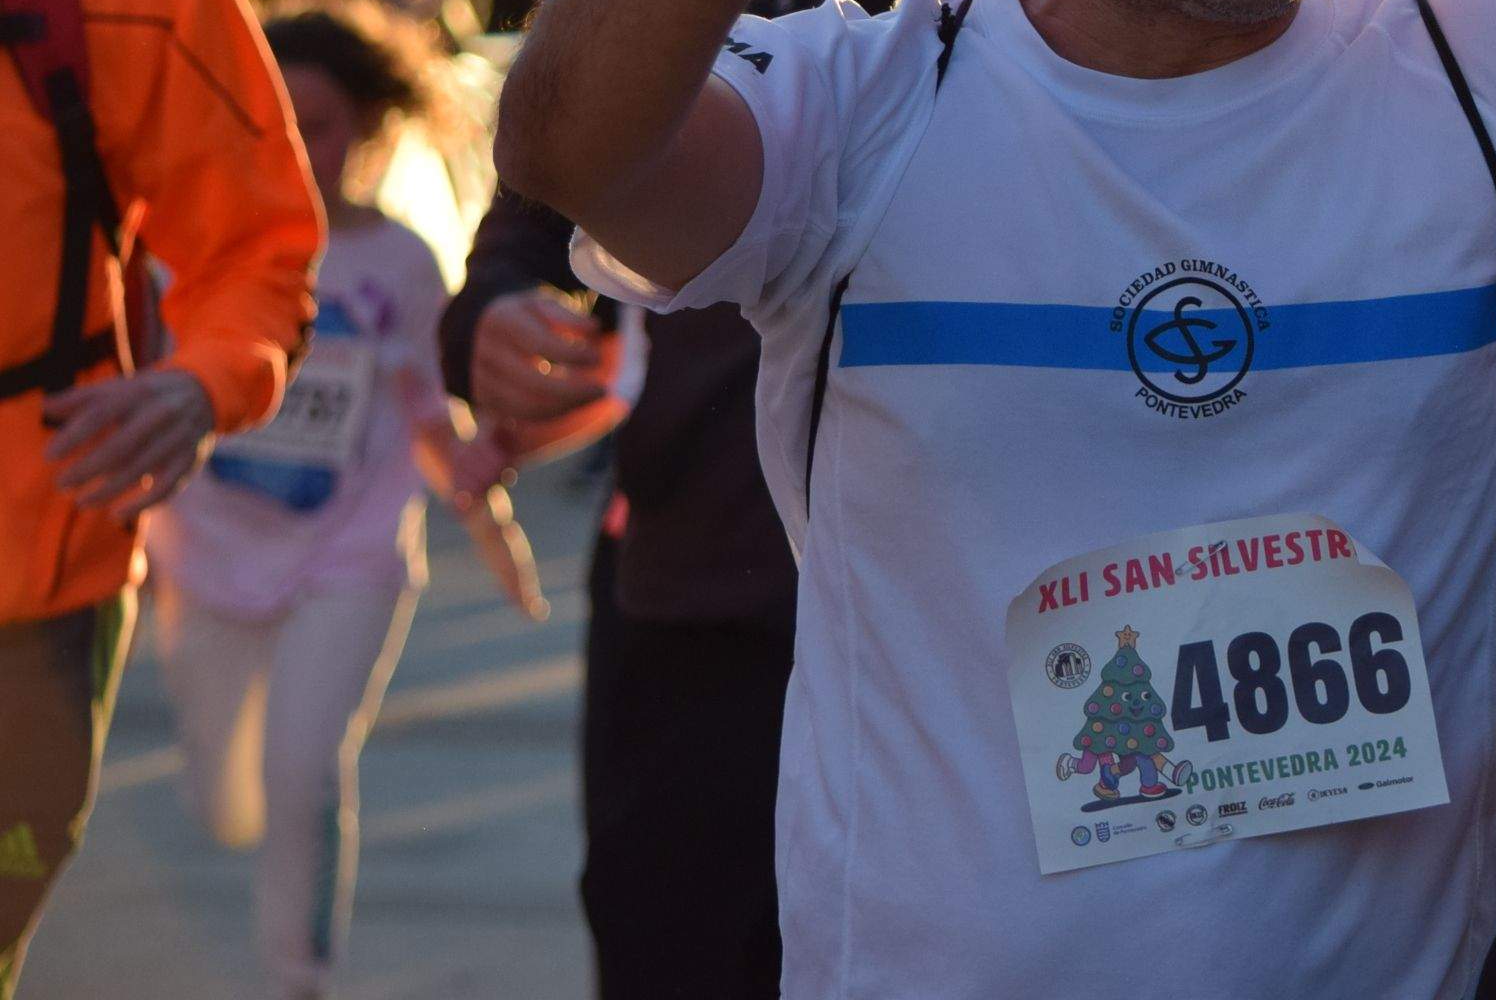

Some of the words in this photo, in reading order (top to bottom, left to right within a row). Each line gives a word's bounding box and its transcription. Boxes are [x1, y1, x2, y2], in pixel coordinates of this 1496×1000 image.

[1109, 262, 1176, 333] SOCIEDAD
[1181, 259, 1271, 332] GIMNASTICA
[1135, 387, 1247, 419] PONTEVEDRA
[1038, 572, 1088, 613] XLI
[1103, 552, 1175, 597] SAN
[1170, 612, 1411, 742] 4866
[1186, 744, 1338, 794] PONTEVEDRA
[1346, 737, 1407, 766] 2024
[1218, 801, 1248, 816] FROIZ
